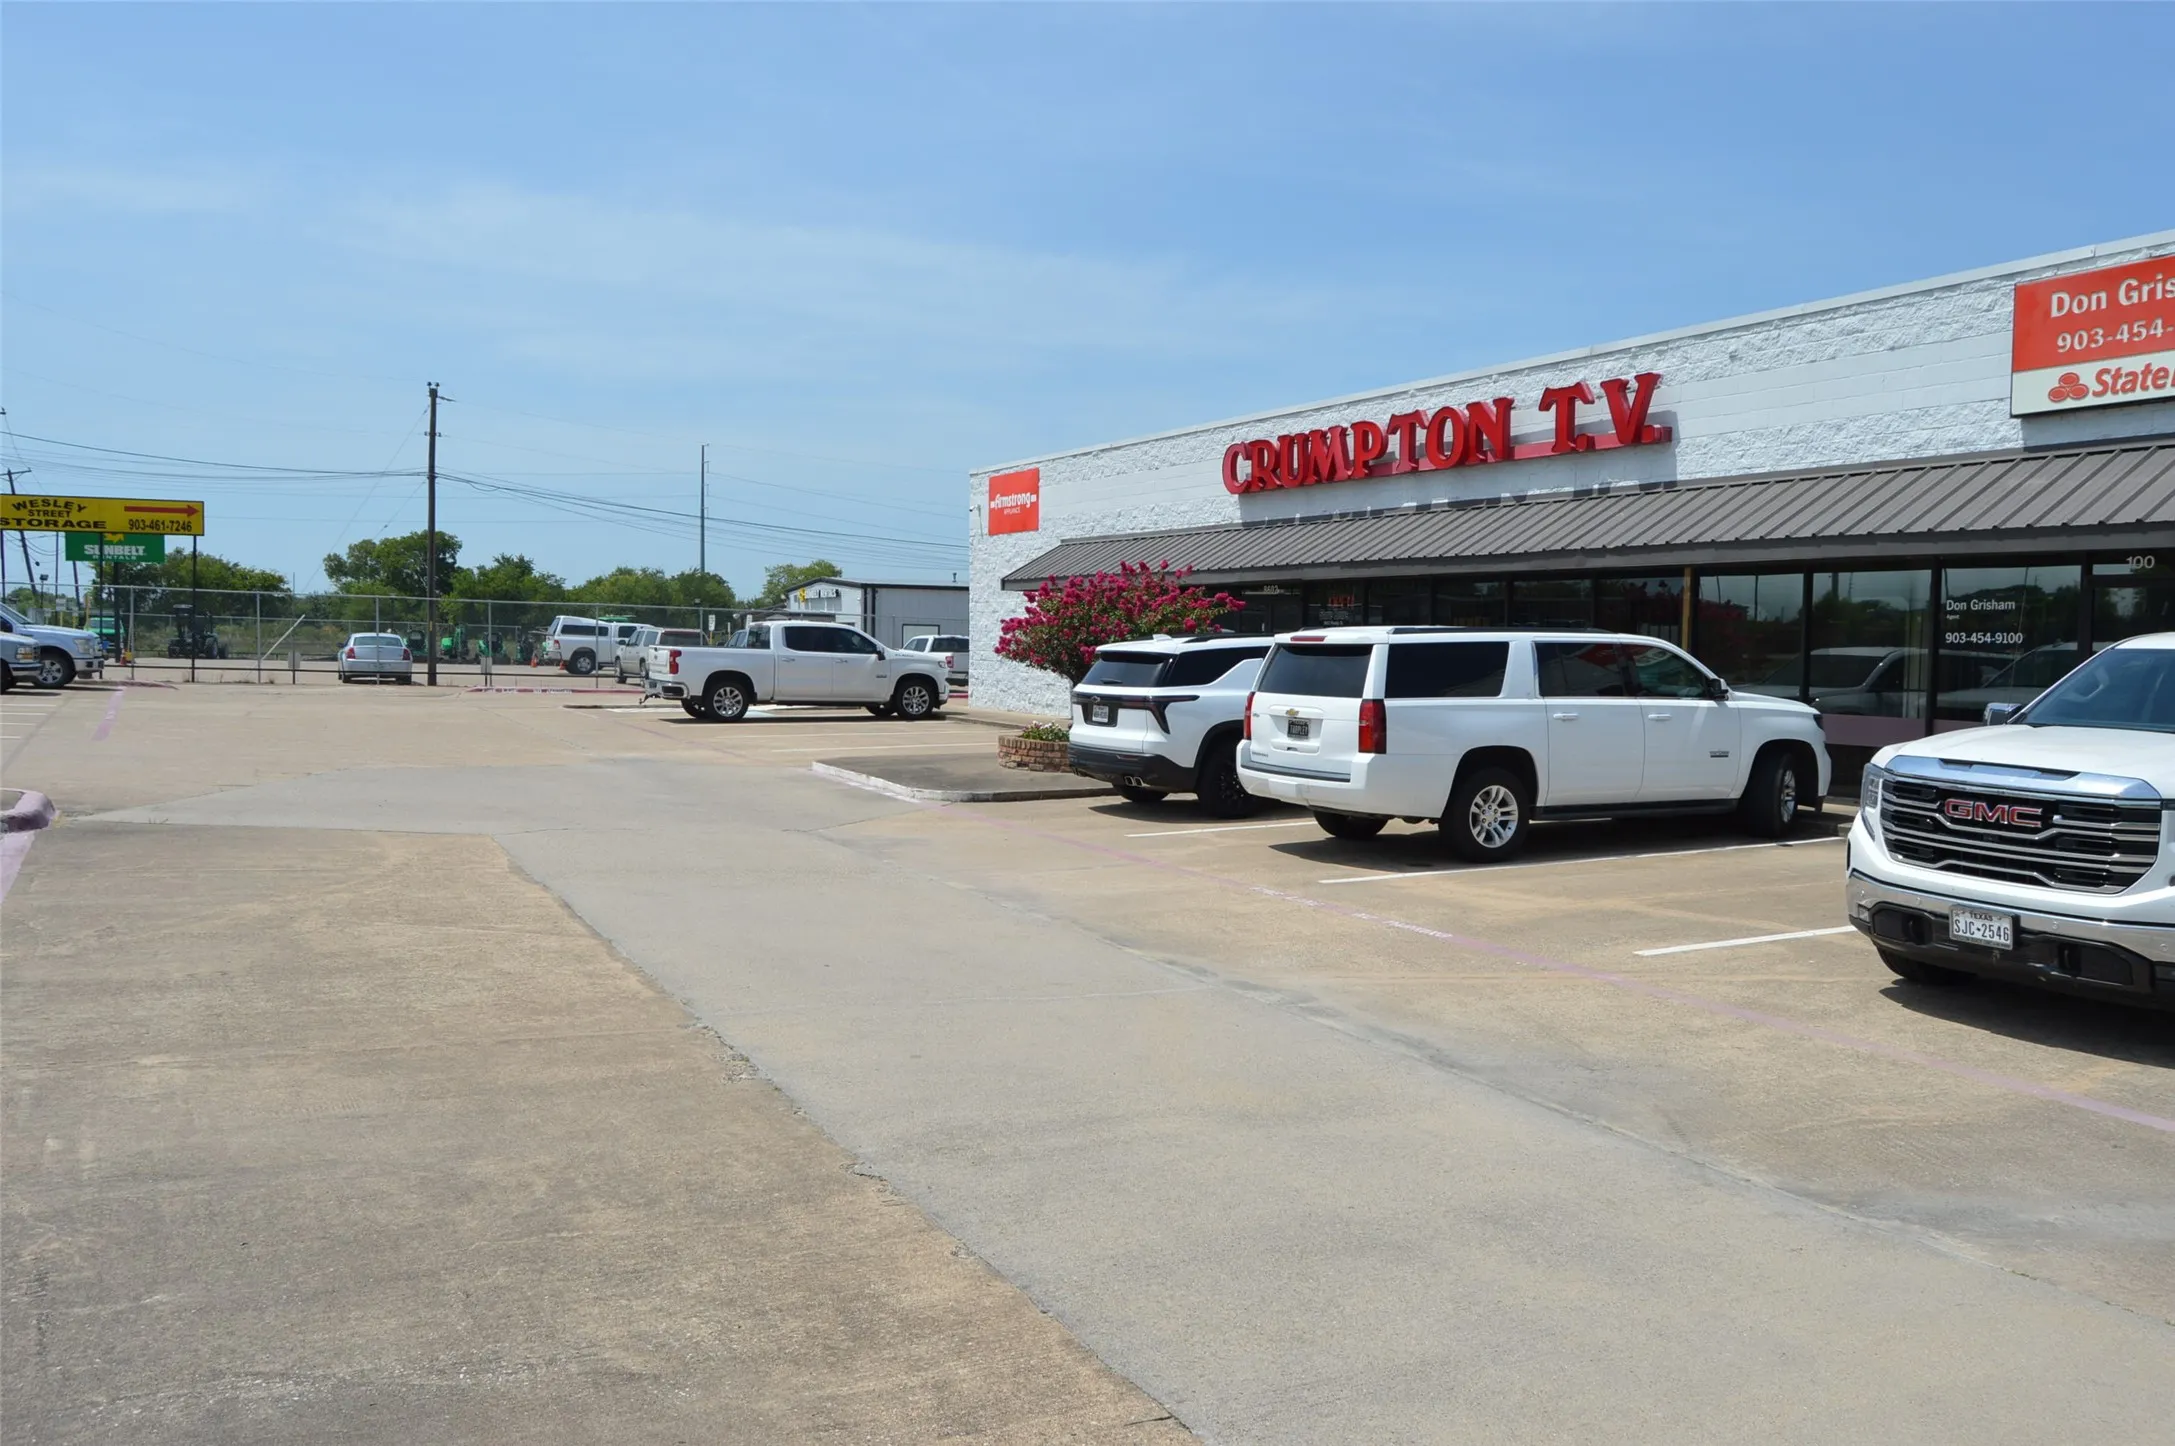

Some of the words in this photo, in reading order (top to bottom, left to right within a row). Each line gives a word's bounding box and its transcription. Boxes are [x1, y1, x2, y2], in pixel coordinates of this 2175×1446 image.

[2051, 290, 2107, 318] Don
[2056, 318, 2174, 352] 903-454-
[1222, 397, 1515, 495] CRUMPTON
[1538, 372, 1673, 452] T.V.
[11, 498, 88, 513] WESLEY
[994, 492, 1031, 509] Armstrong
[28, 510, 72, 518] STREET
[0, 517, 107, 529] STORAGE
[128, 519, 192, 532] 903-461-7246
[2126, 555, 2155, 569] 100
[1946, 600, 1967, 610] Don
[1970, 599, 2016, 610] Grisham
[1945, 632, 2023, 644] 903-454-9100
[1944, 798, 2043, 828] GMC
[1969, 911, 1994, 921] TEXAS
